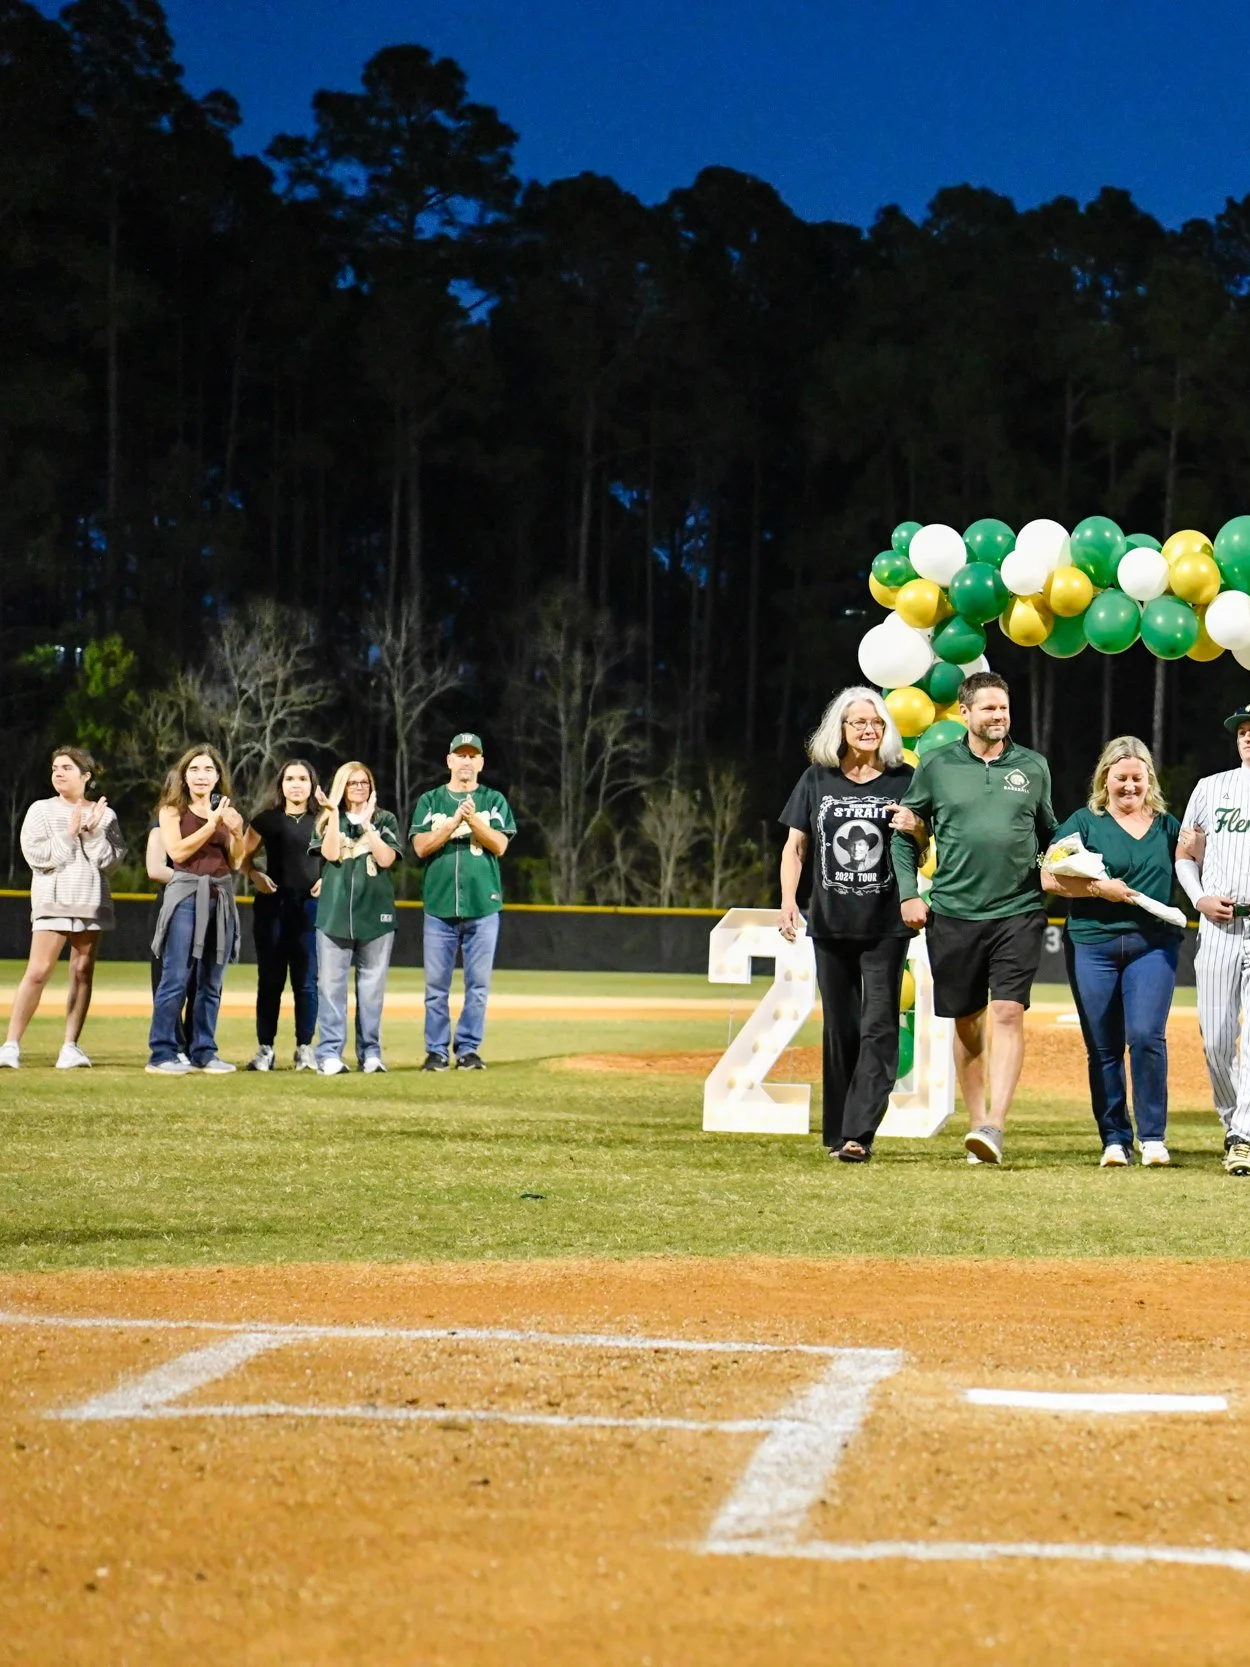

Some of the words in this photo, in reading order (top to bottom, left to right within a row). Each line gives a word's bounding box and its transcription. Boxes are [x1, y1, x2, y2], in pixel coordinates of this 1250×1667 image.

[833, 807, 888, 819] STRAIT
[835, 871, 854, 882] 2024
[857, 872, 877, 882] TOUR
